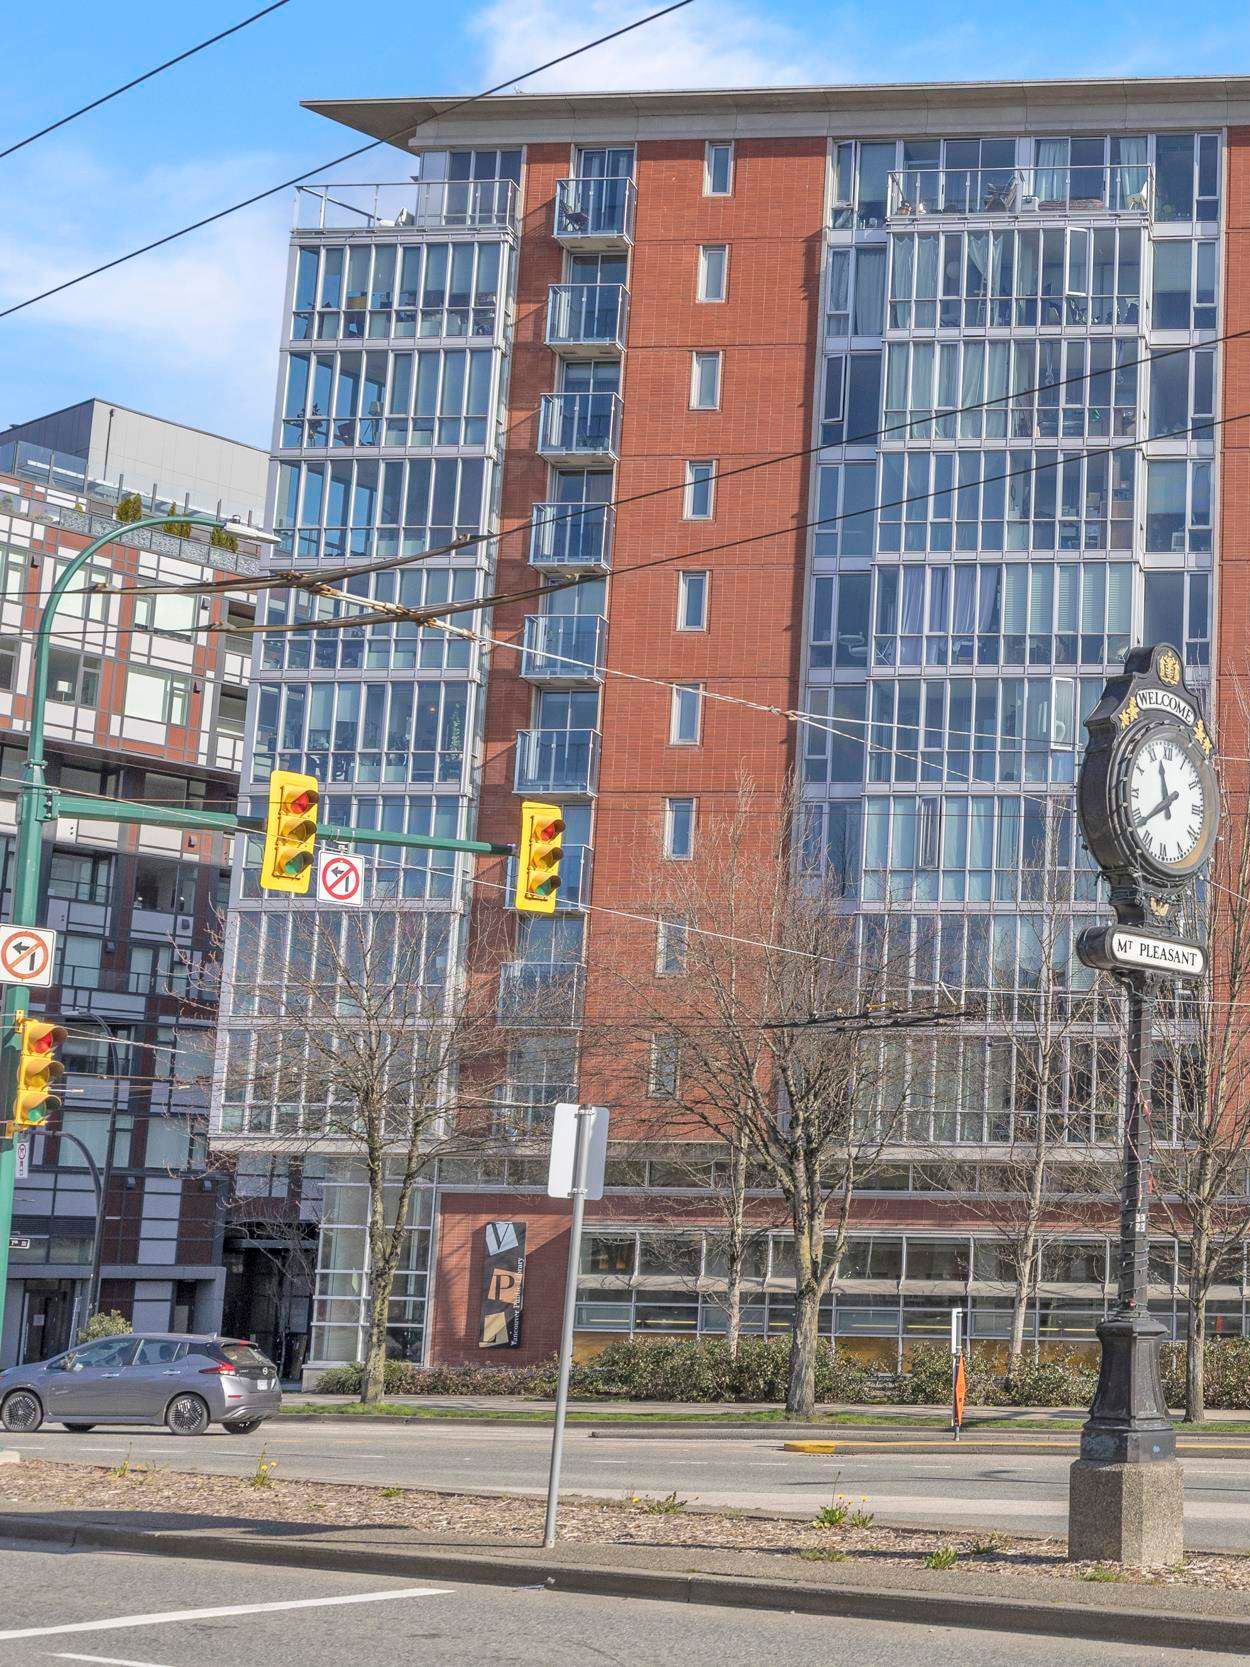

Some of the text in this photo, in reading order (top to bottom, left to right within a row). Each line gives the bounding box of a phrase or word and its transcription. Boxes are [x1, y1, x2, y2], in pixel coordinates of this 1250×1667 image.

[1138, 691, 1194, 723] WELCOME
[1139, 943, 1197, 966] PLEASANT
[509, 1310, 520, 1346] Vancouver
